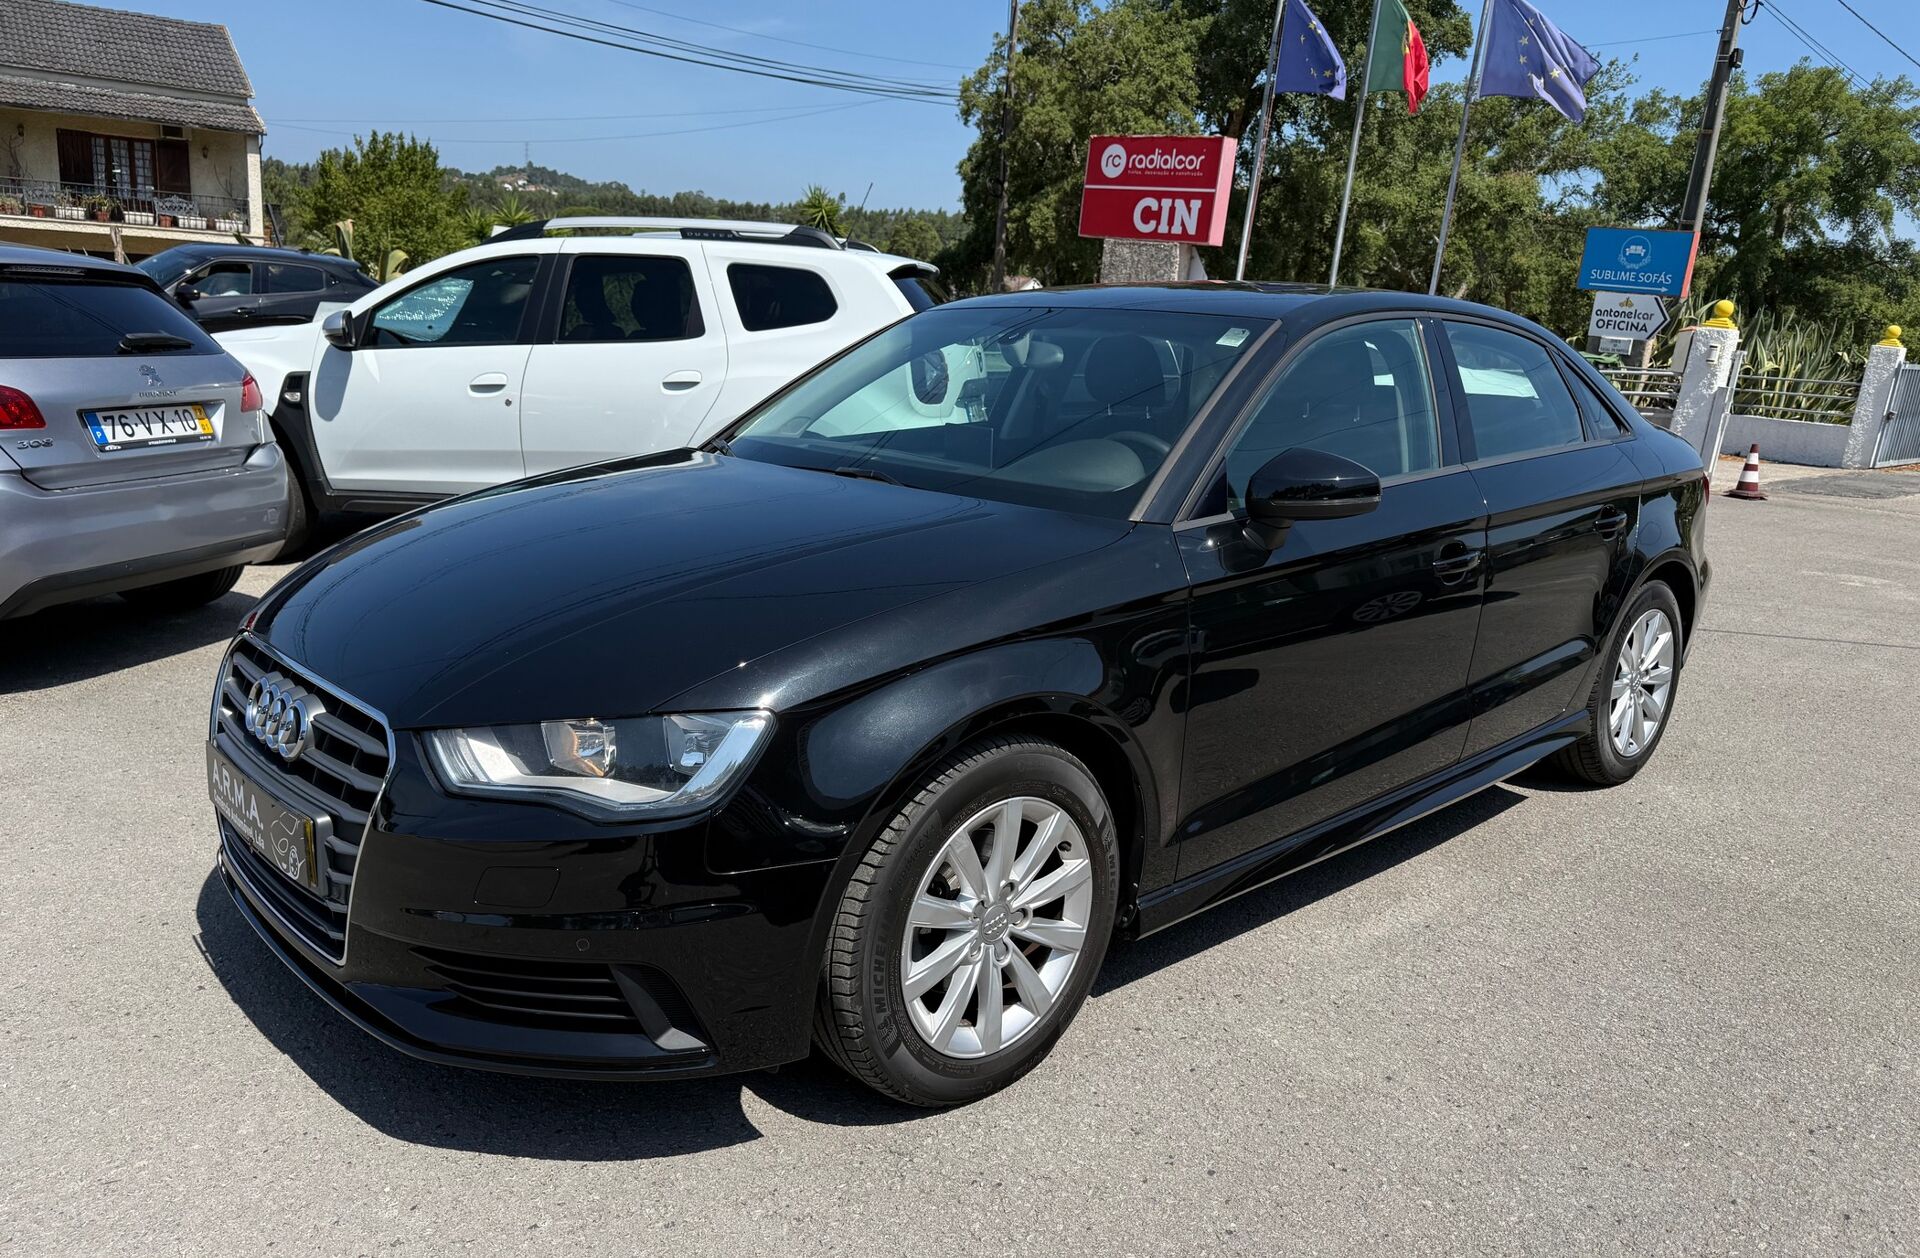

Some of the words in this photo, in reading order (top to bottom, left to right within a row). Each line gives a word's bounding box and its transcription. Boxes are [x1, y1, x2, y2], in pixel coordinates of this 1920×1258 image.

[1128, 148, 1206, 170] radialcor
[1133, 197, 1202, 235] CIN
[1590, 268, 1636, 282] SUBLIME
[1637, 272, 1672, 285] SOFÁS
[1595, 308, 1655, 320] antonelcar
[1596, 319, 1648, 333] OFICINA
[17, 438, 54, 450] 308
